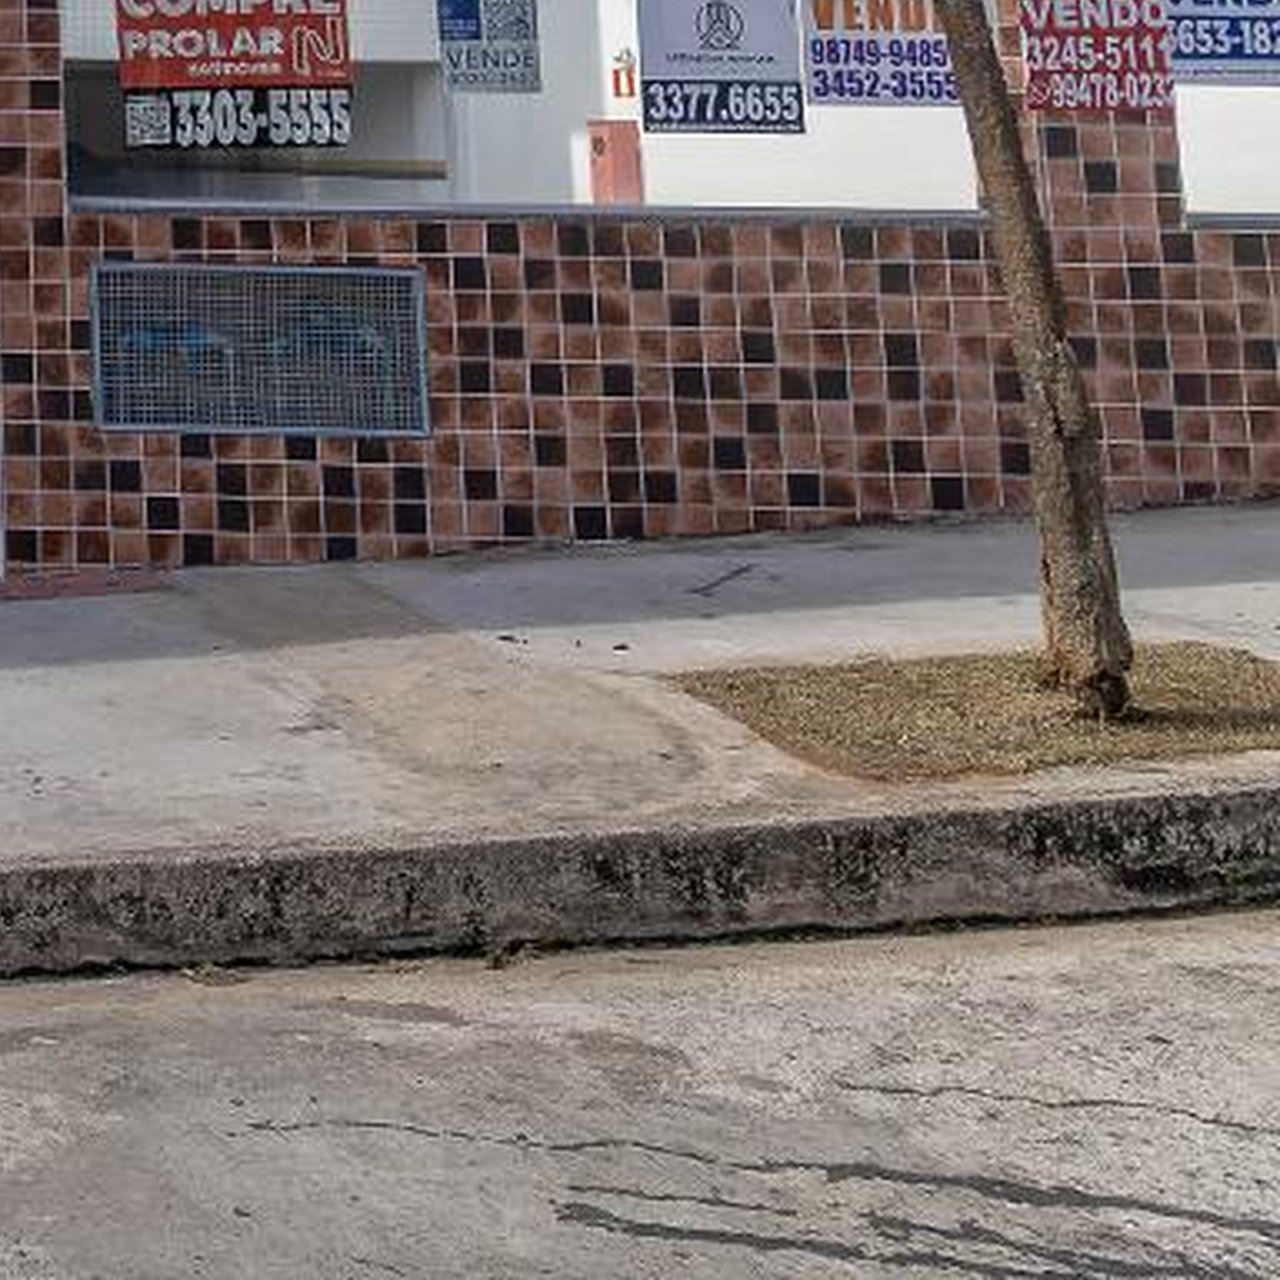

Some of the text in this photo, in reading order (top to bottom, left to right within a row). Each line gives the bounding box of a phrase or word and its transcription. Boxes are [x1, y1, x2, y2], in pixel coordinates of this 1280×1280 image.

[123, 26, 284, 58] PROLAR
[447, 48, 535, 70] VENDE
[813, 70, 960, 100] 3452-3555
[172, 88, 352, 147] 3303-5555
[648, 82, 800, 121] 3377.6655
